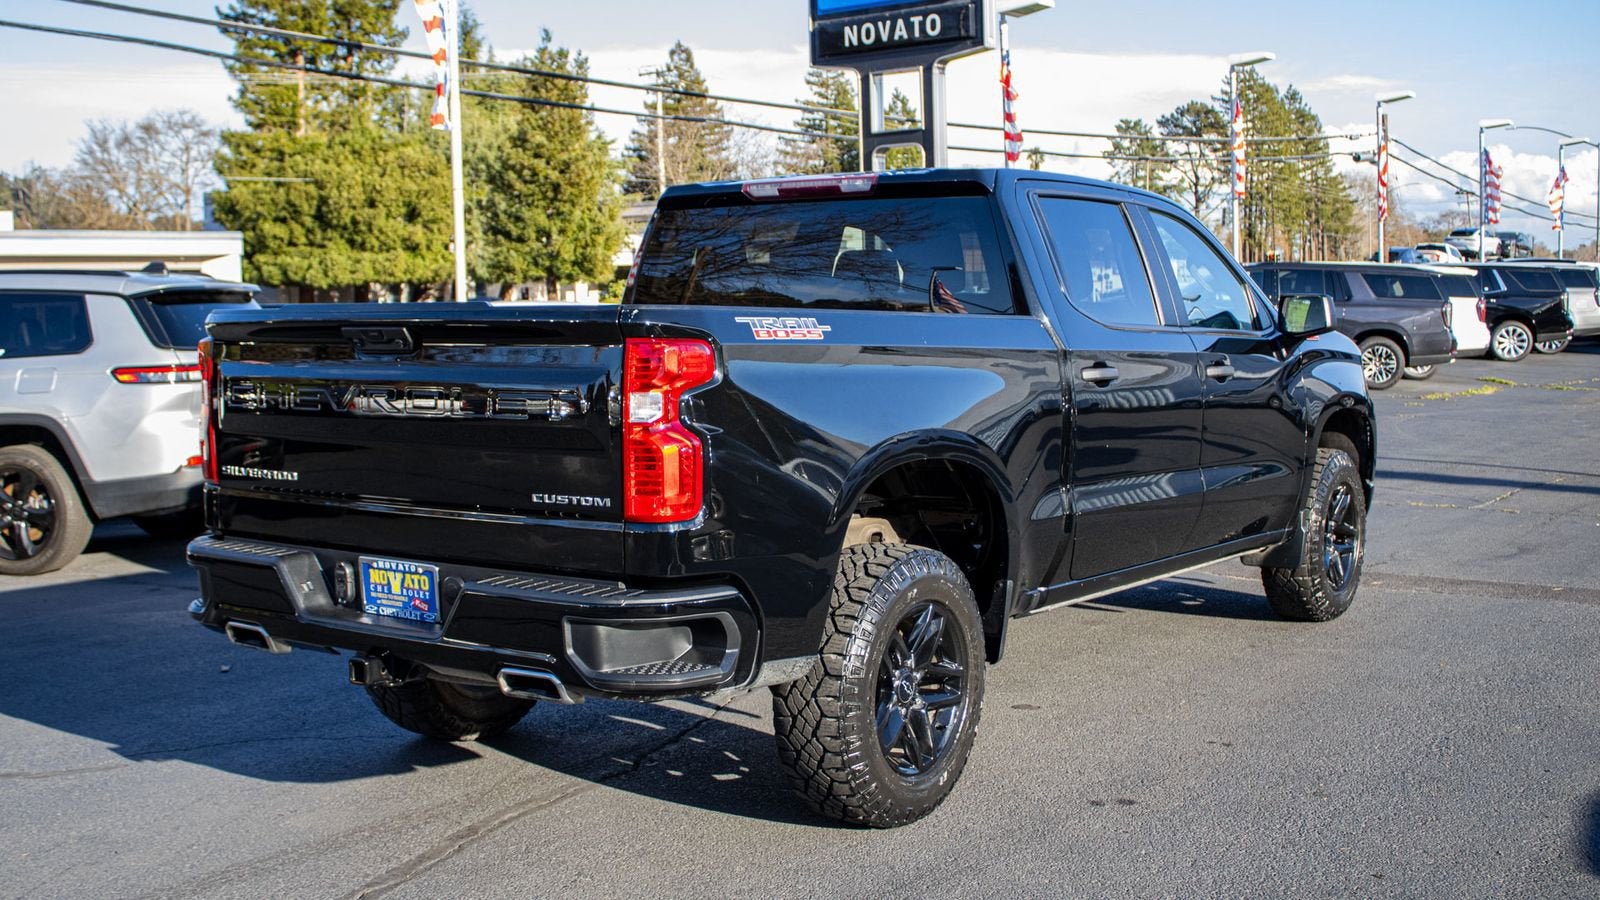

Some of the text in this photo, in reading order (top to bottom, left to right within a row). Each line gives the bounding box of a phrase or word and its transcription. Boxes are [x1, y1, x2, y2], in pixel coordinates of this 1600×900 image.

[844, 13, 941, 47] NOVATO
[734, 317, 832, 331] TRAIL
[753, 329, 824, 340] BOSS
[227, 383, 587, 421] CHEVROLET
[222, 465, 298, 480] SILVERADO
[531, 493, 611, 507] CUSTOM
[377, 560, 416, 573] NOVATO
[369, 568, 429, 594] NOVATO
[379, 606, 420, 621] CHEVROLET
